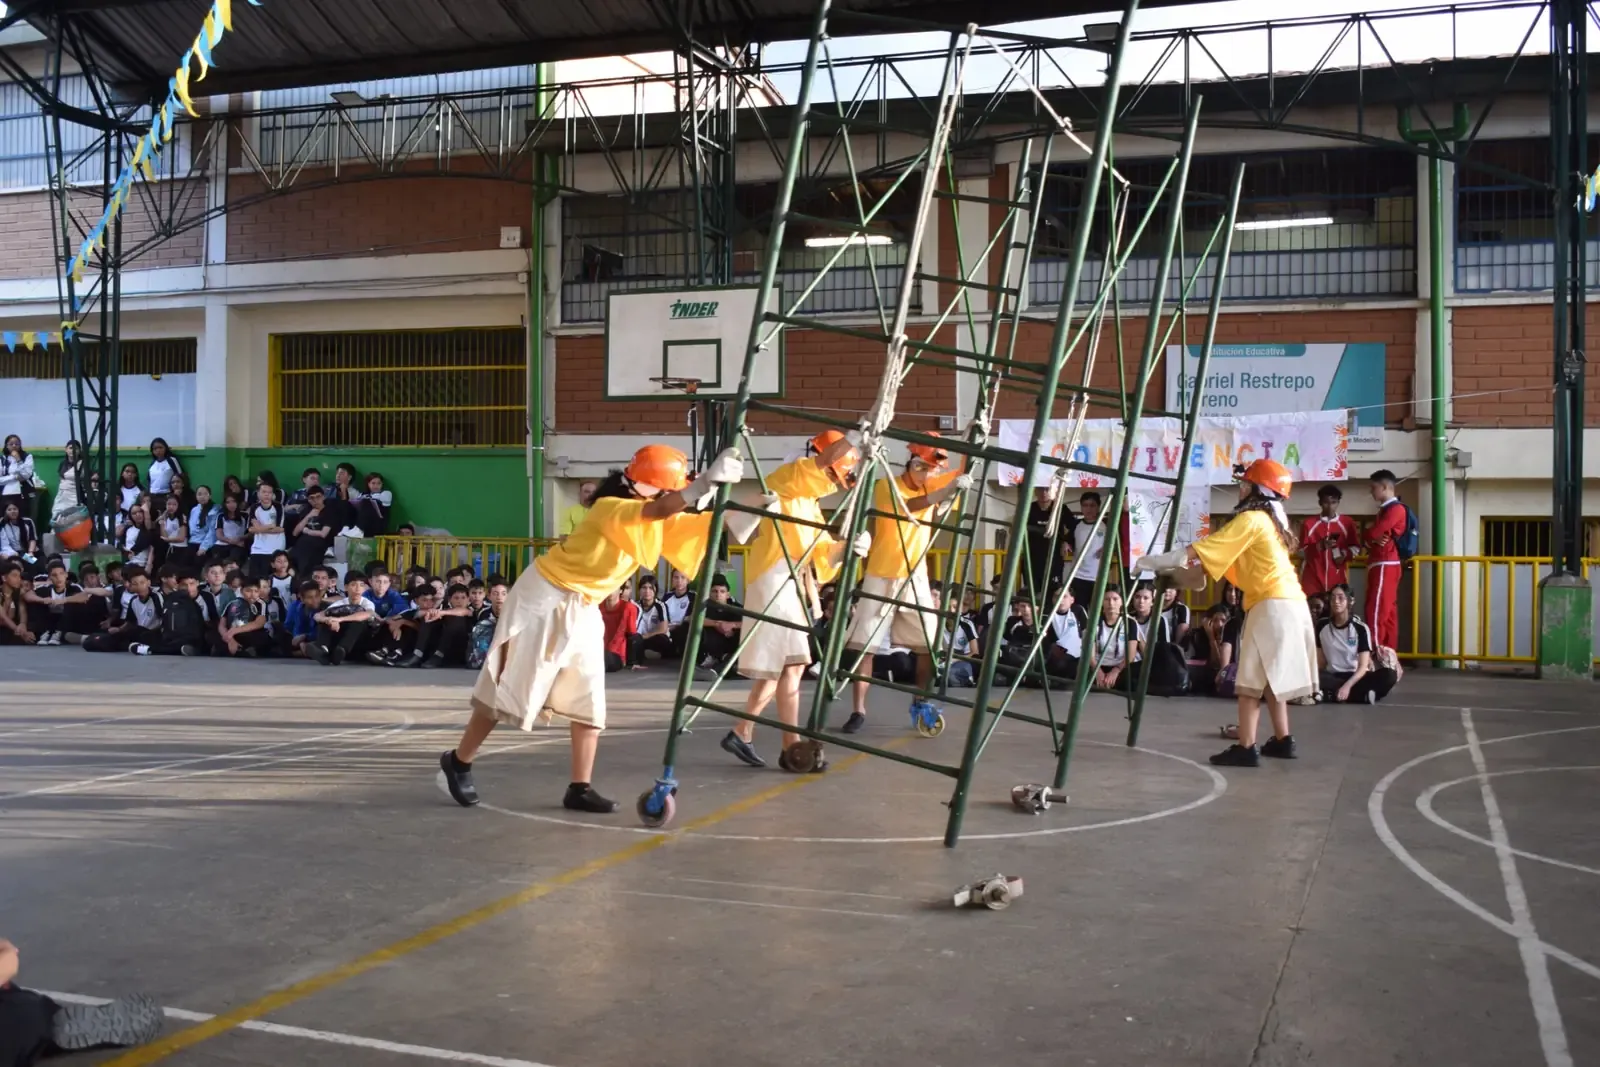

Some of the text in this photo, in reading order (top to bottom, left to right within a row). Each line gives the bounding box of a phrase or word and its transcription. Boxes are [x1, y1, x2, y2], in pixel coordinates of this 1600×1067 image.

[1245, 346, 1286, 356] Educativa
[1176, 372, 1315, 392] Gariel Restrepo
[1176, 391, 1238, 408] Mreno
